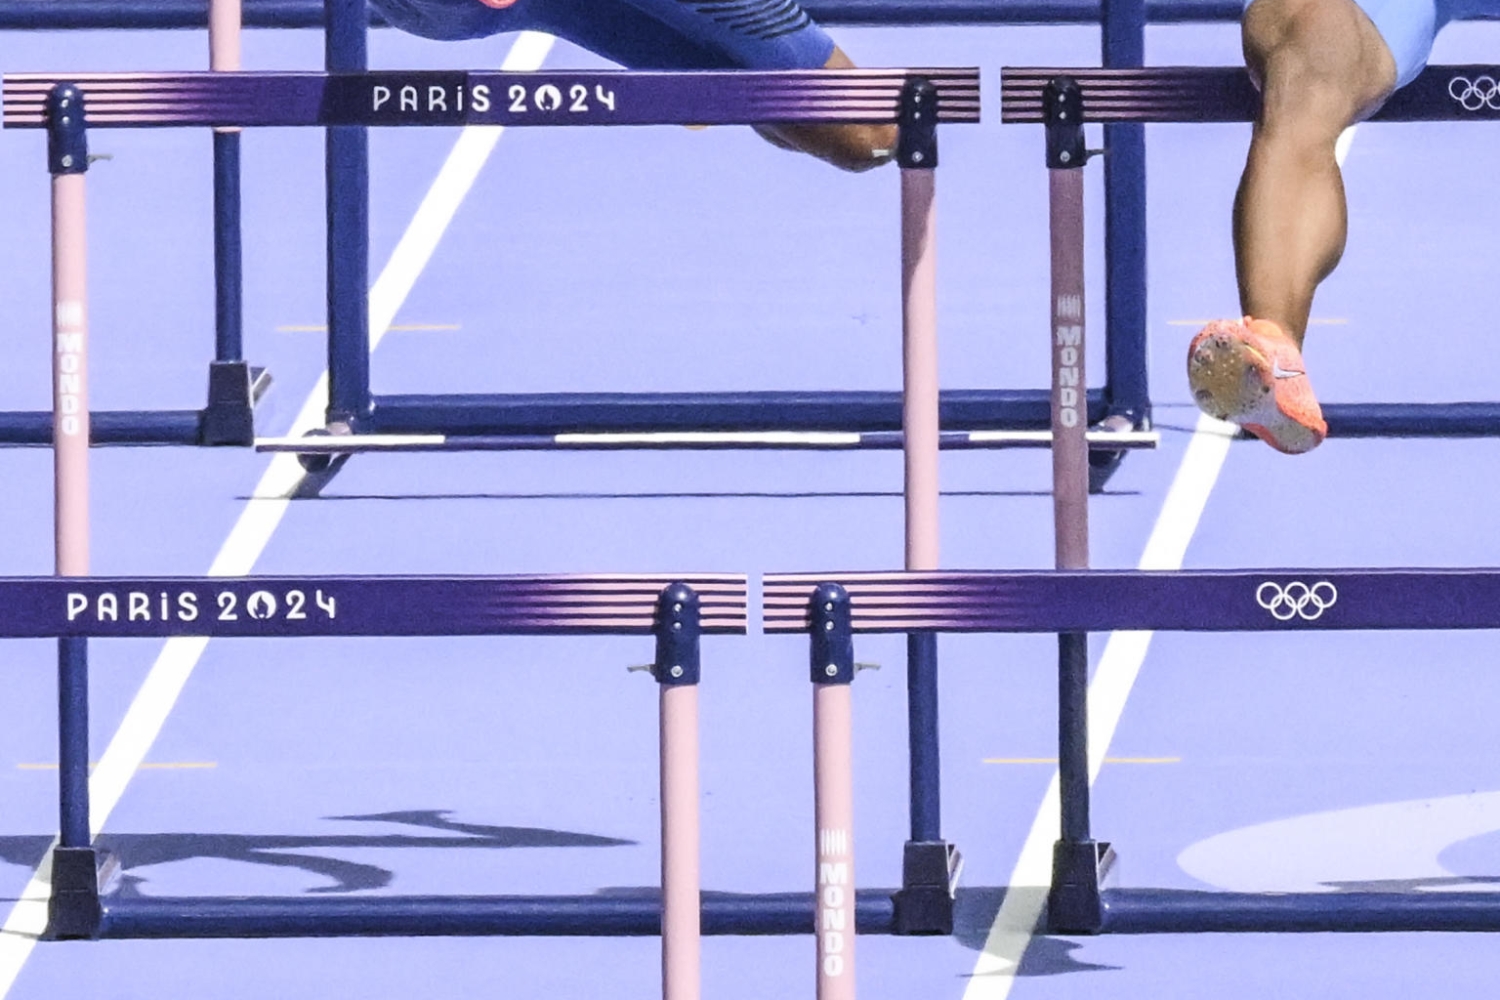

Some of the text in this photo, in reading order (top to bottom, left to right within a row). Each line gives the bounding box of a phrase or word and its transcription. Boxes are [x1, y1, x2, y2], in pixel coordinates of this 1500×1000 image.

[508, 84, 615, 112] 2024
[57, 332, 82, 435] MONDO
[1057, 325, 1081, 428] MONDO
[217, 589, 336, 620] 2024
[820, 862, 847, 976] MONDO
